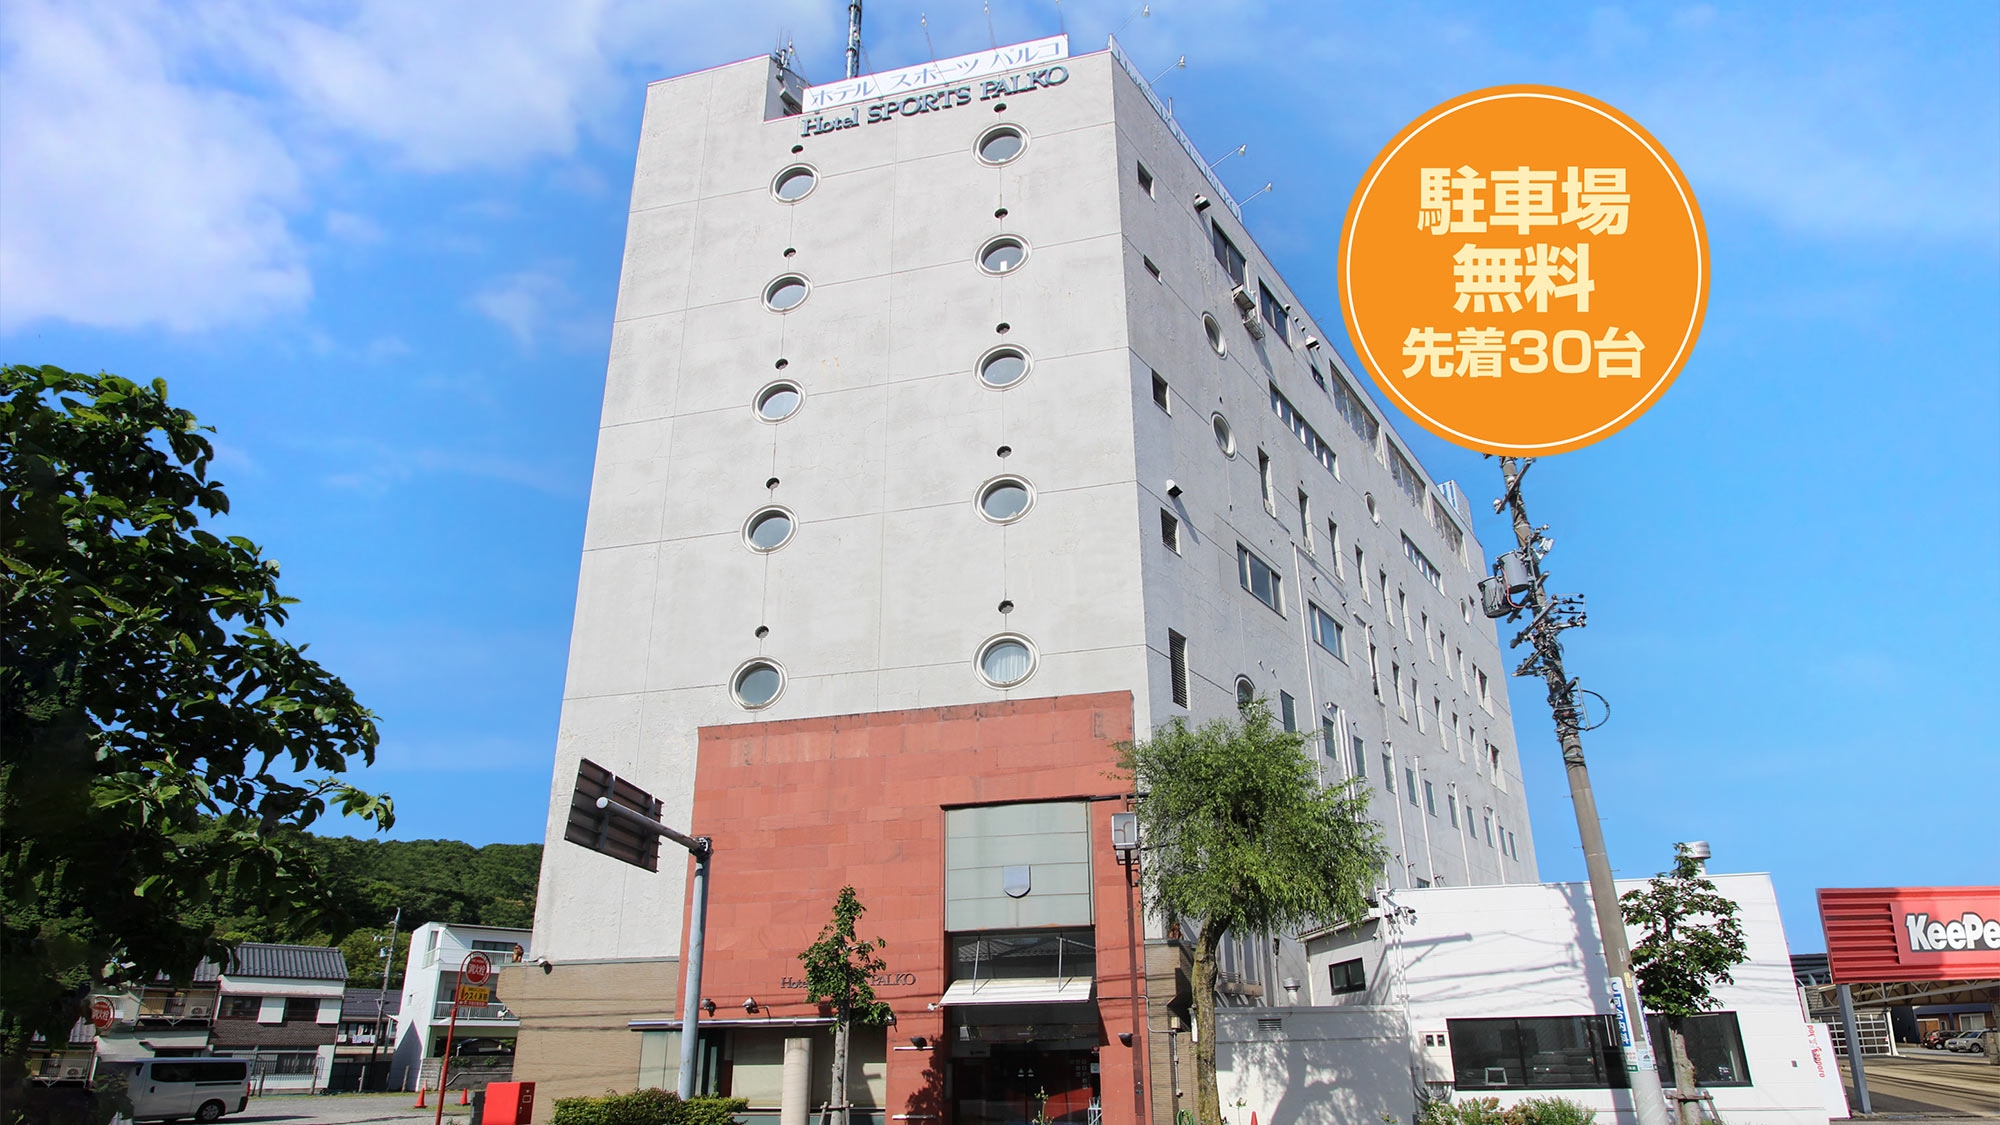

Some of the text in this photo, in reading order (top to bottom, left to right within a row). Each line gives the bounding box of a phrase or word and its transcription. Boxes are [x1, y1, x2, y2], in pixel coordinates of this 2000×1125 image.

[800, 65, 1069, 137] Hotel SPORTS PALKO
[810, 80, 876, 107] ホテル
[890, 58, 979, 87] スポーツ
[781, 973, 916, 989] Hote PALKO
